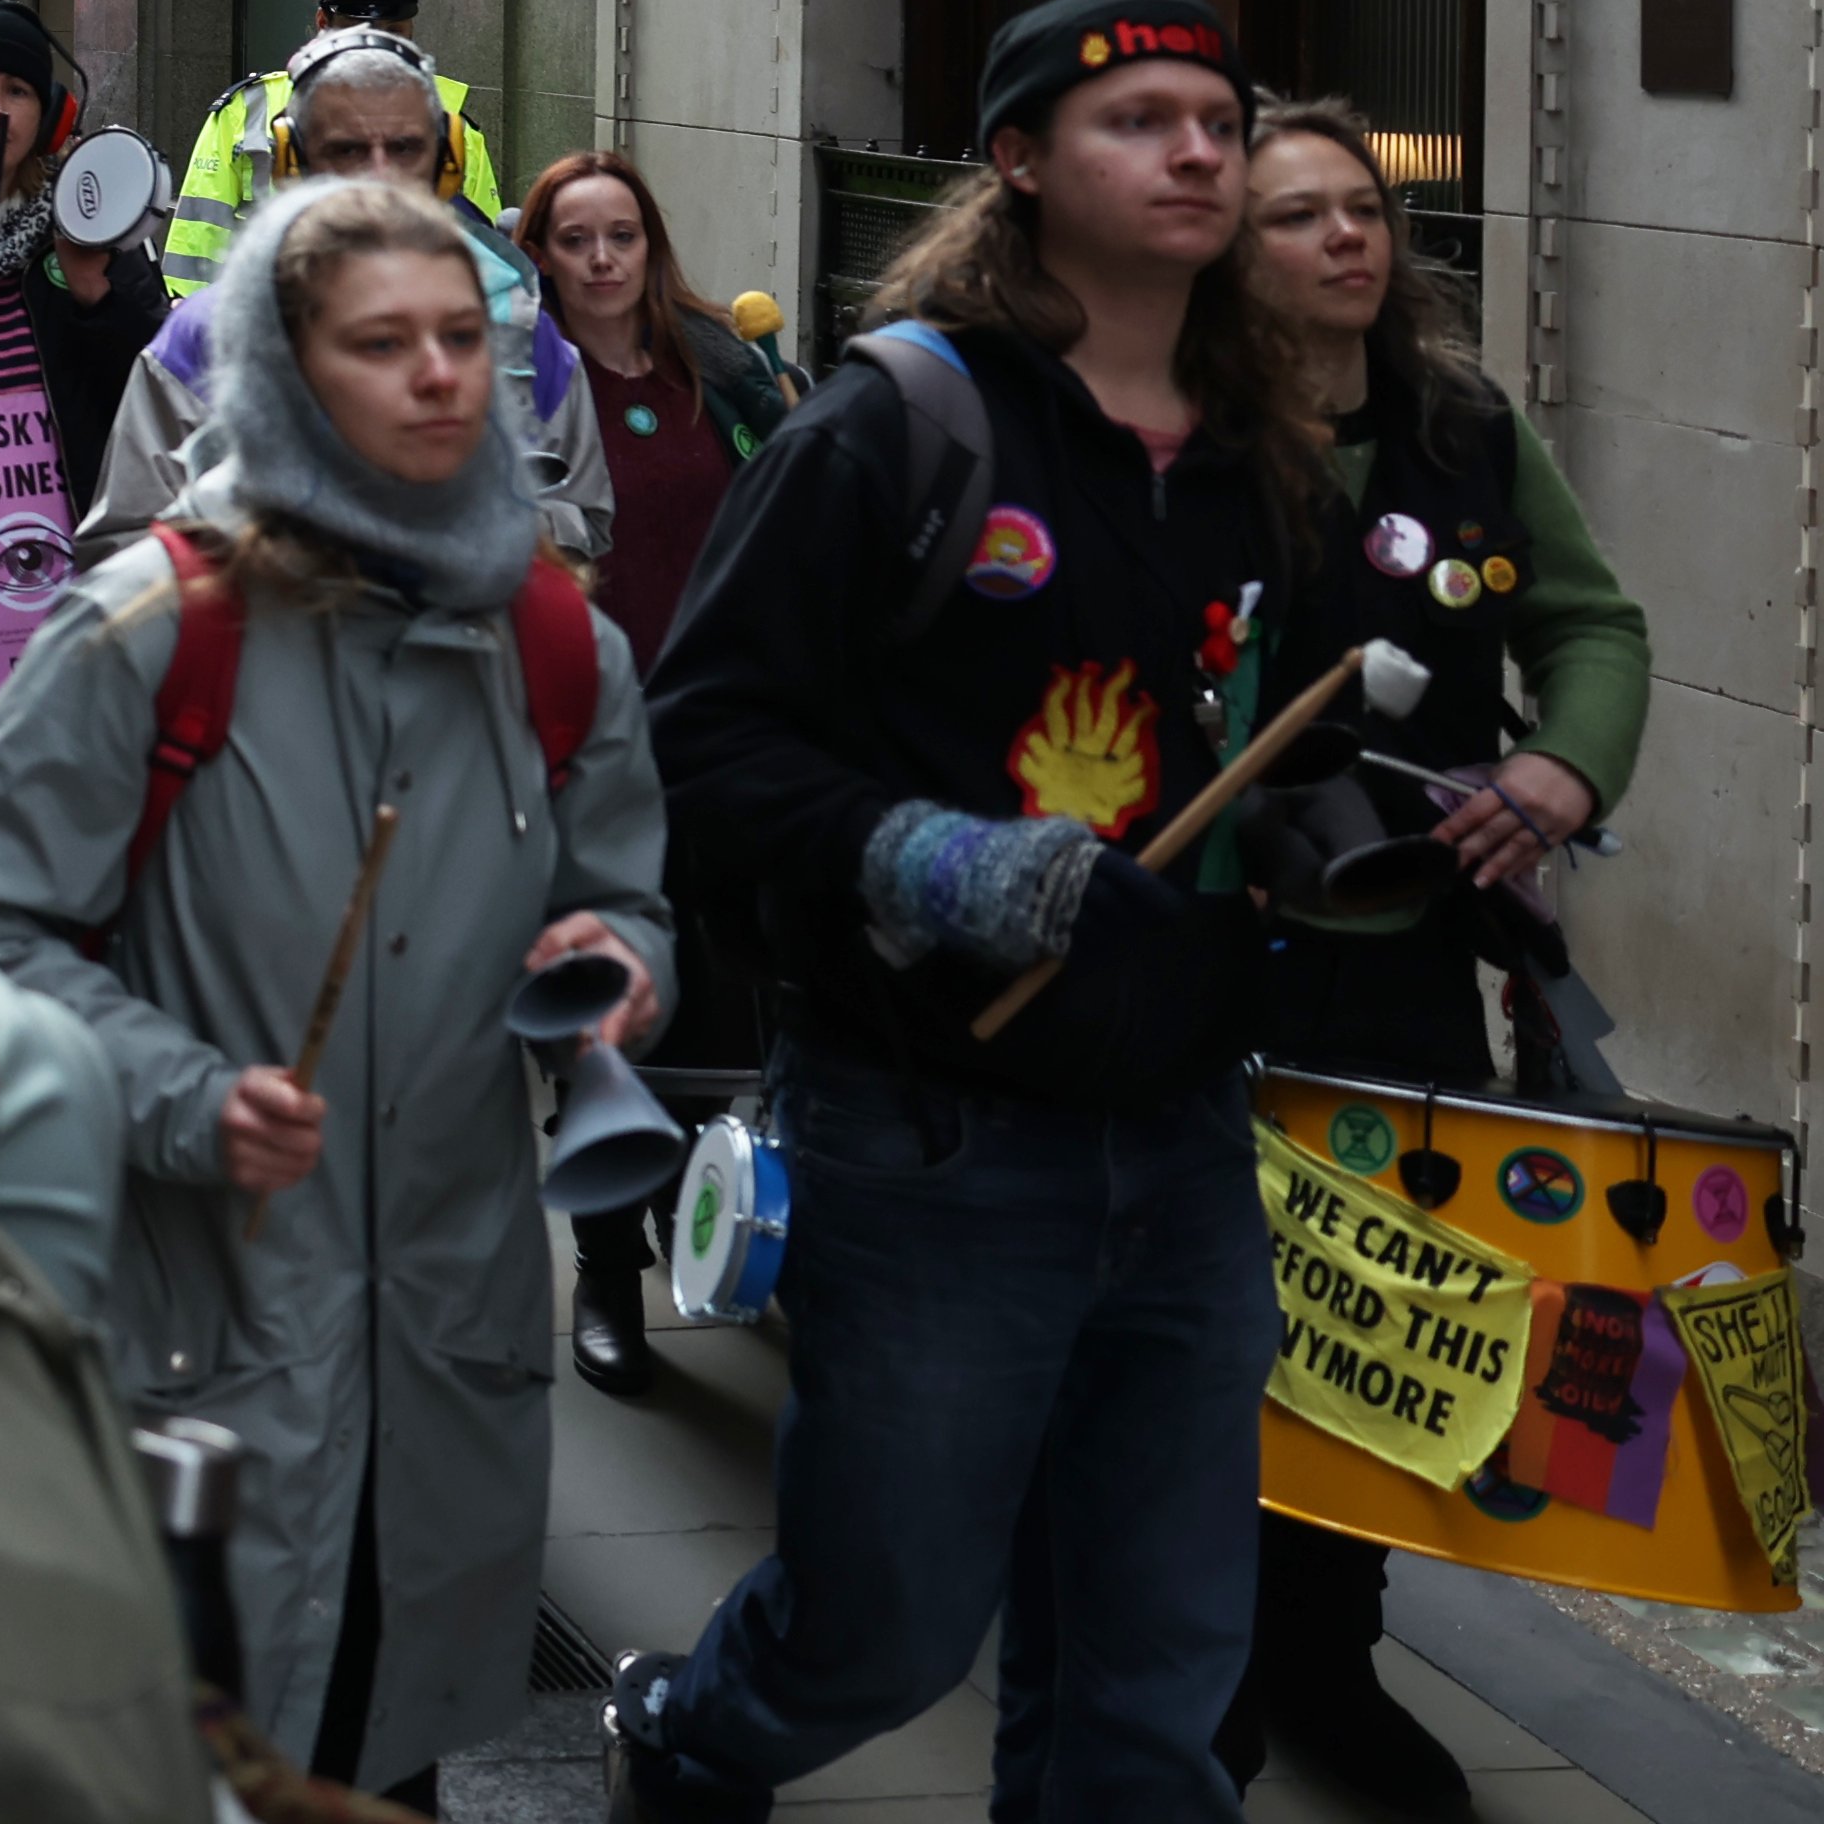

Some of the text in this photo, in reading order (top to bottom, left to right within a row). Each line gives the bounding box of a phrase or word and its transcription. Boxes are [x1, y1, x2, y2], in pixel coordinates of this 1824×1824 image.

[193, 158, 220, 172] POLICE
[1286, 1168, 1504, 1306] WE CAN'T
[1271, 1226, 1511, 1385] FFORD THIS
[1280, 1312, 1457, 1438] NYMORE
